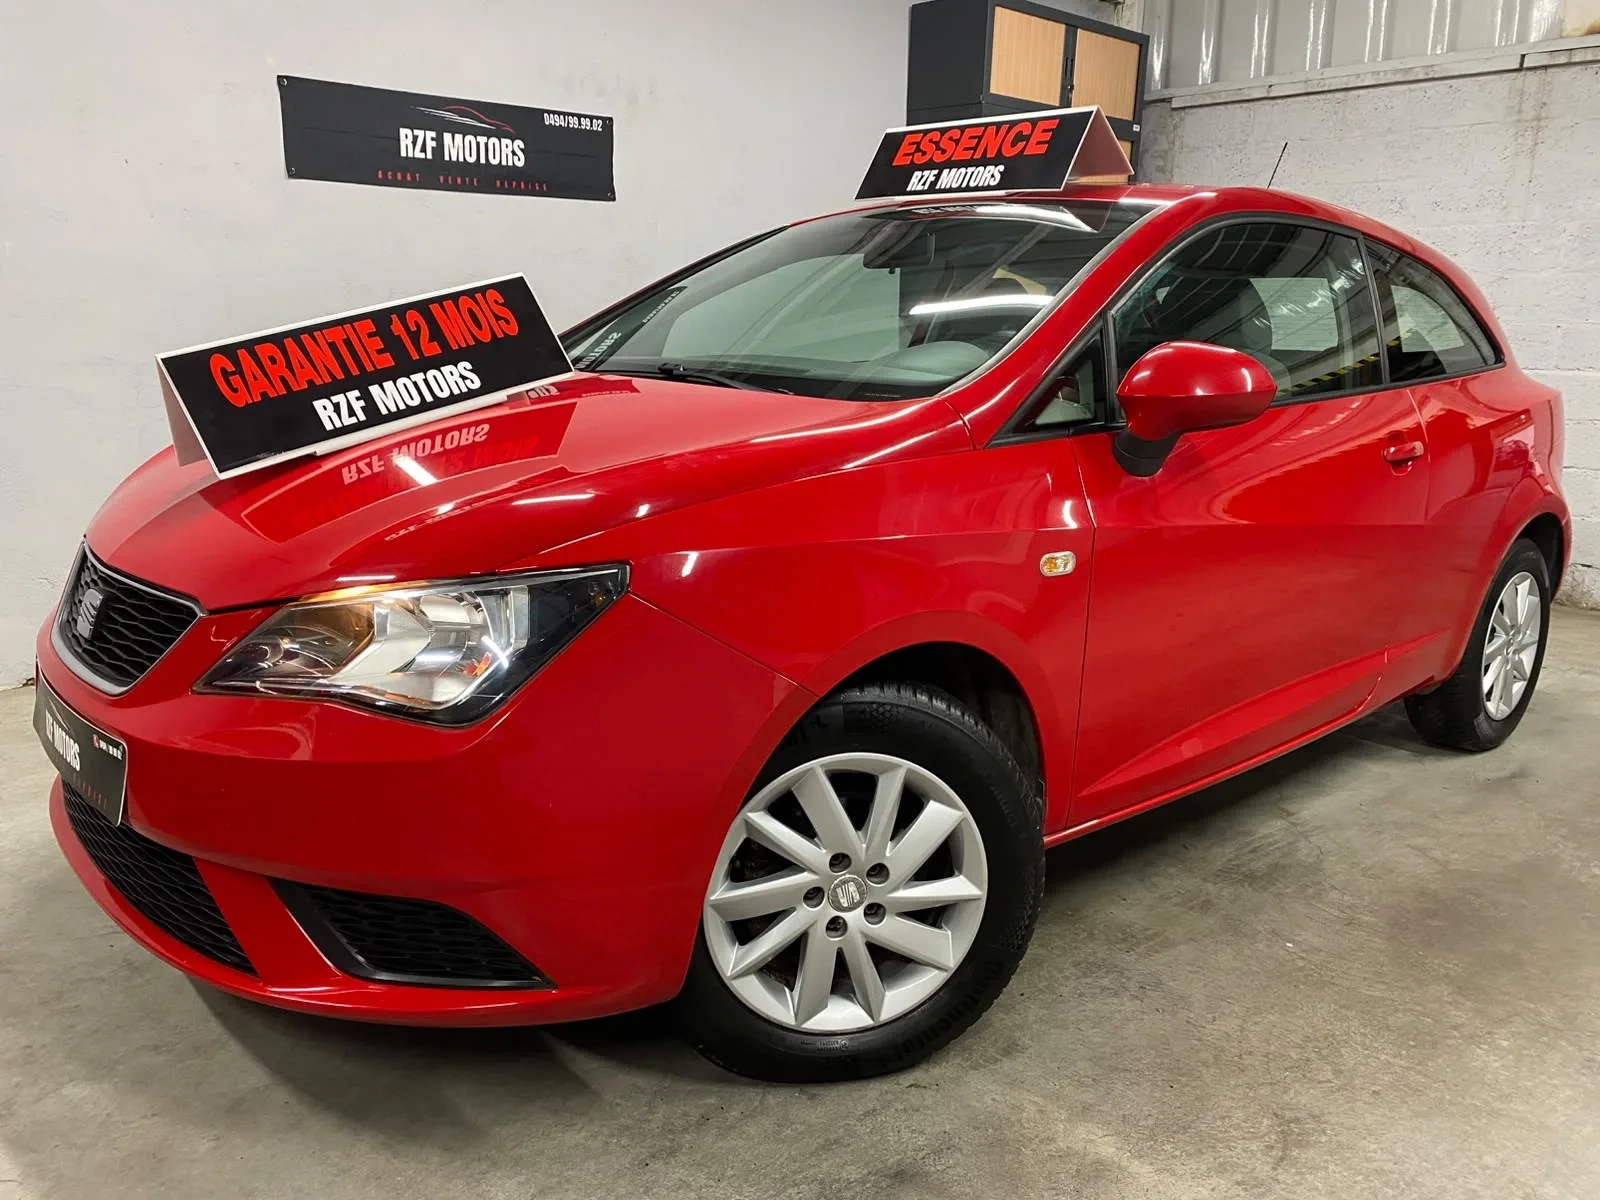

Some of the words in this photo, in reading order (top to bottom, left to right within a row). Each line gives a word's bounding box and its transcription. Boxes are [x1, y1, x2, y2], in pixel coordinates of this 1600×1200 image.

[543, 112, 603, 131] 0494/99.99.02
[892, 118, 1060, 166] ESSENCE
[399, 127, 437, 159] RZF
[443, 132, 525, 167] MOTORS
[906, 170, 938, 192] RZF
[936, 165, 1005, 190] MOTORS
[208, 320, 394, 408] GARANTIE
[389, 308, 442, 361] 12
[430, 288, 520, 350] MOIS
[312, 389, 368, 432] RZF
[367, 361, 482, 415] MOTORS
